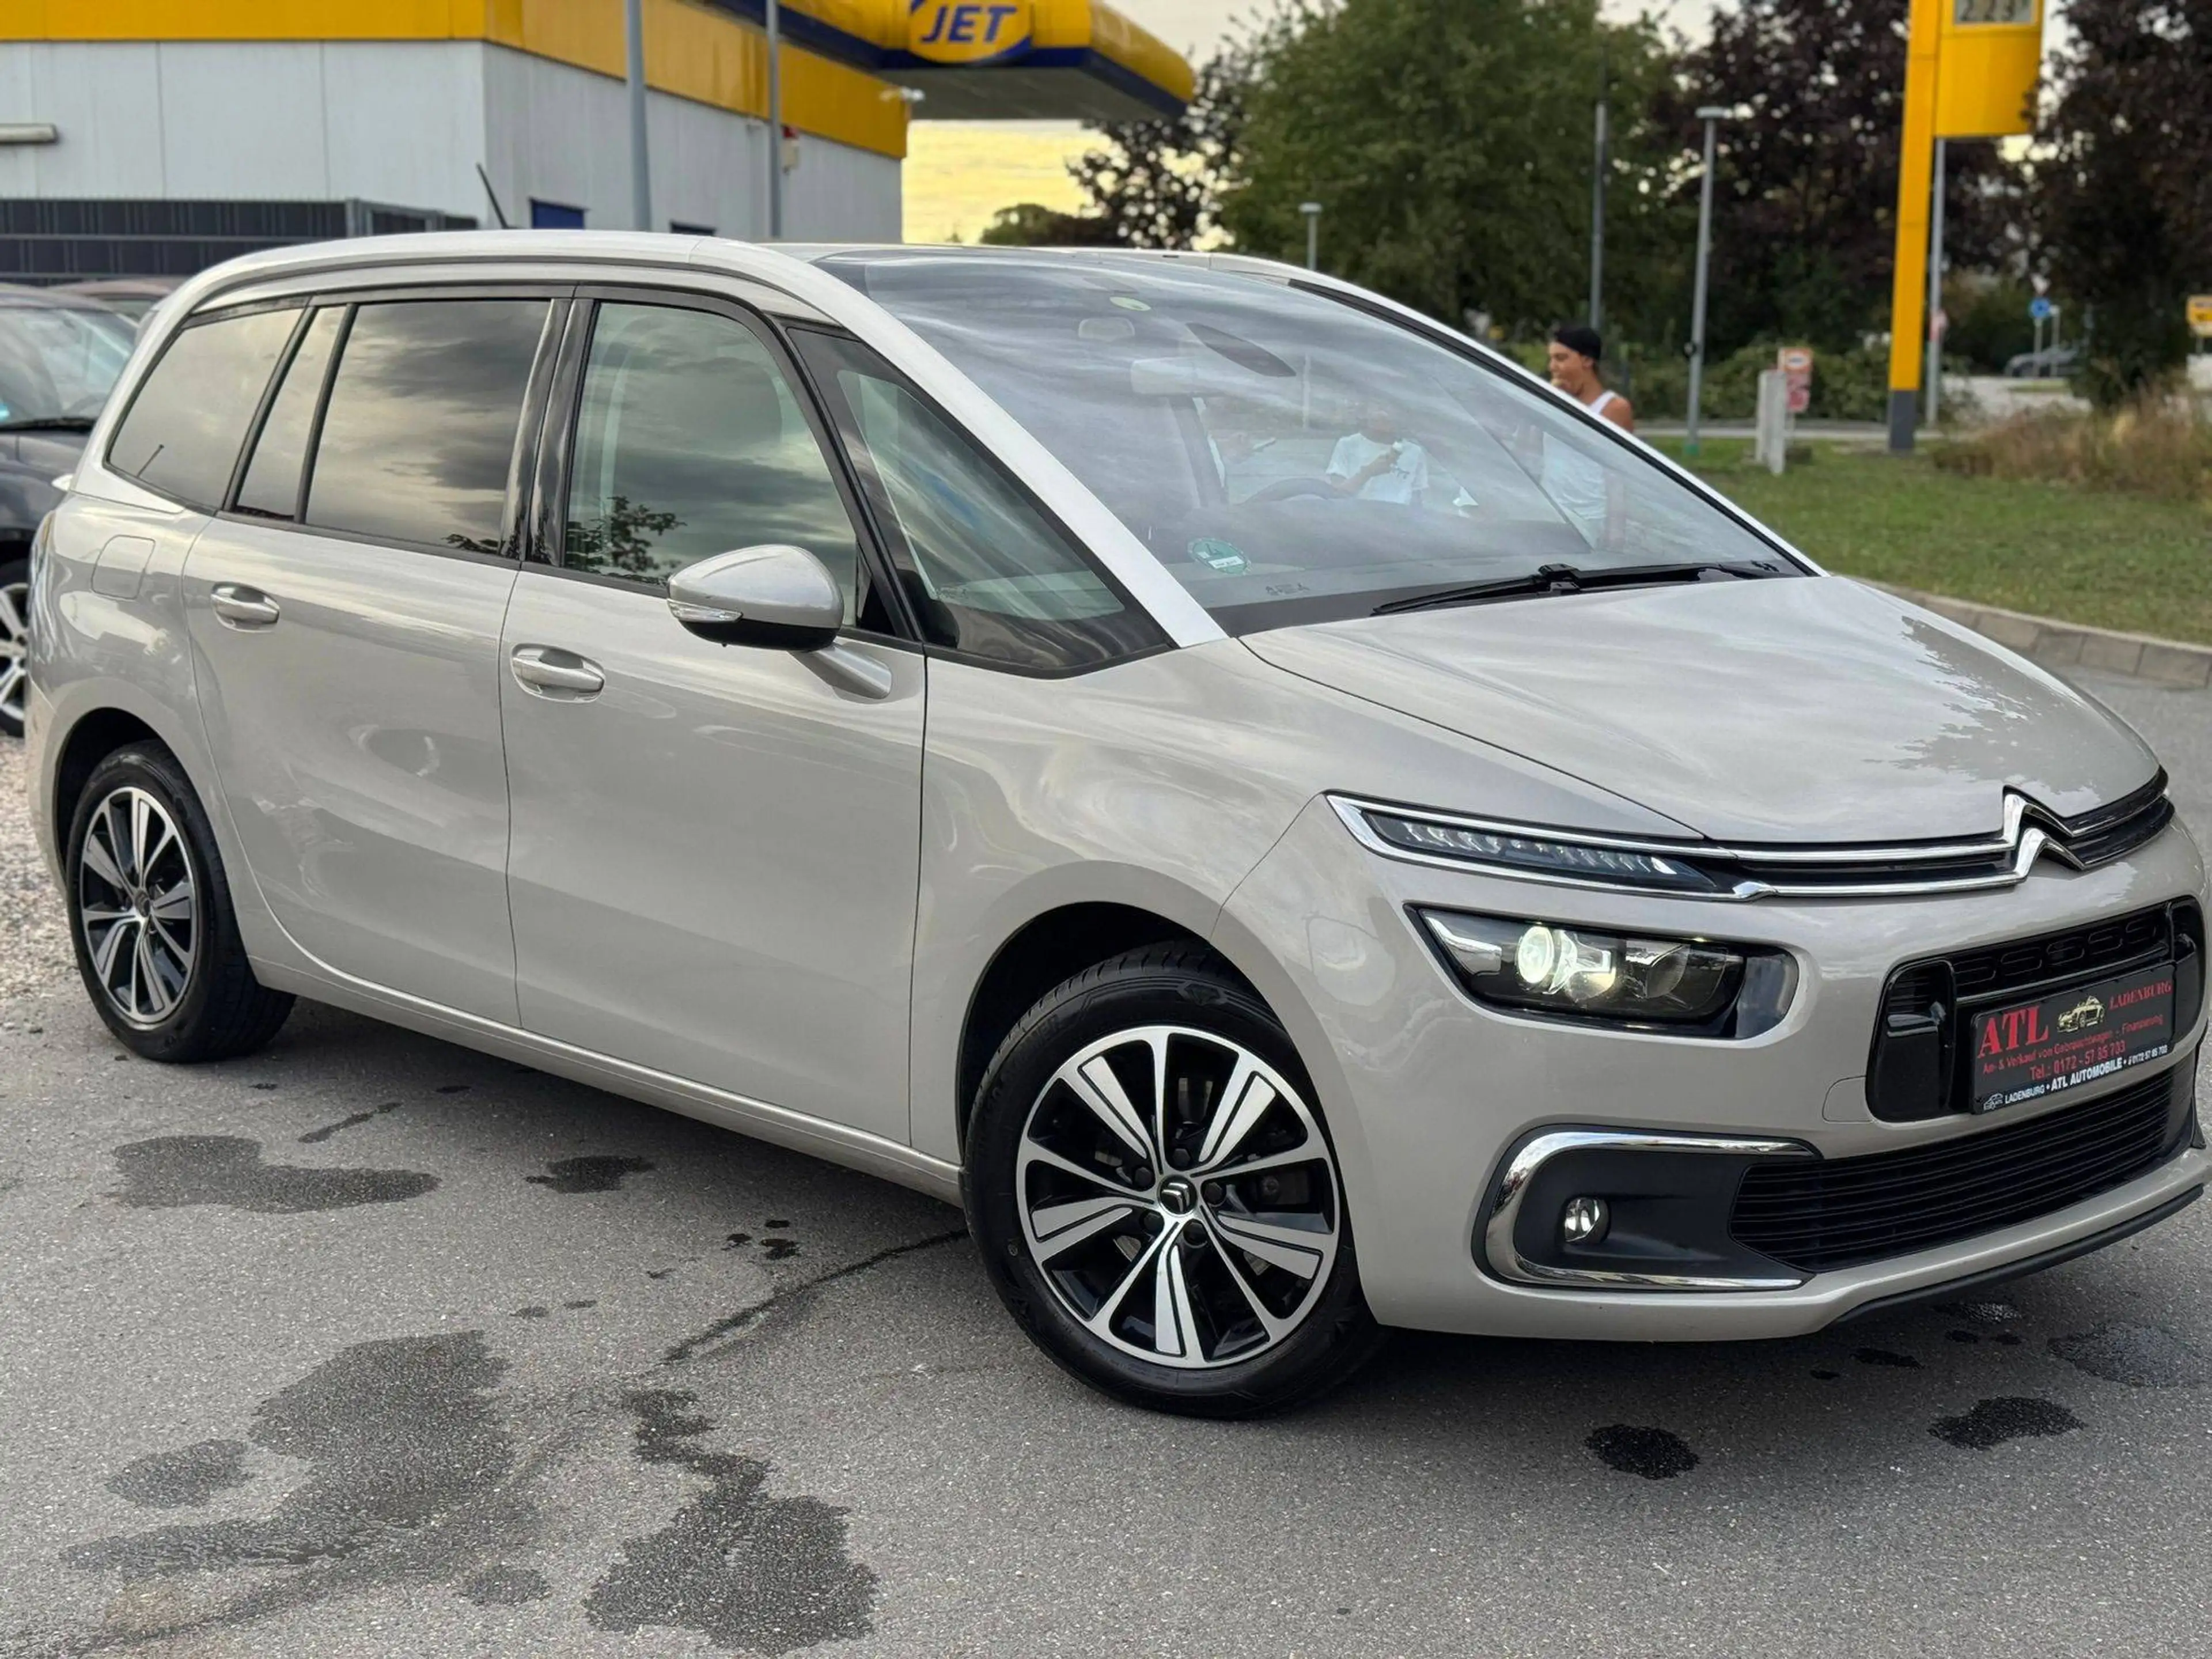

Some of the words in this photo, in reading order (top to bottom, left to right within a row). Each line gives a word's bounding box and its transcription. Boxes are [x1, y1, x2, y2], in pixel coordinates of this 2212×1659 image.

[921, 6, 1017, 43] JET
[2109, 980, 2172, 1010] LADENBURG
[1977, 1005, 2049, 1059] ATL
[2054, 1055, 2077, 1074] 0172
[2085, 1049, 2095, 1065] 57
[2005, 1084, 2045, 1104] LADENBURG
[2051, 1075, 2068, 1092] ATL
[2069, 1057, 2123, 1085] AUTOMOBILE
